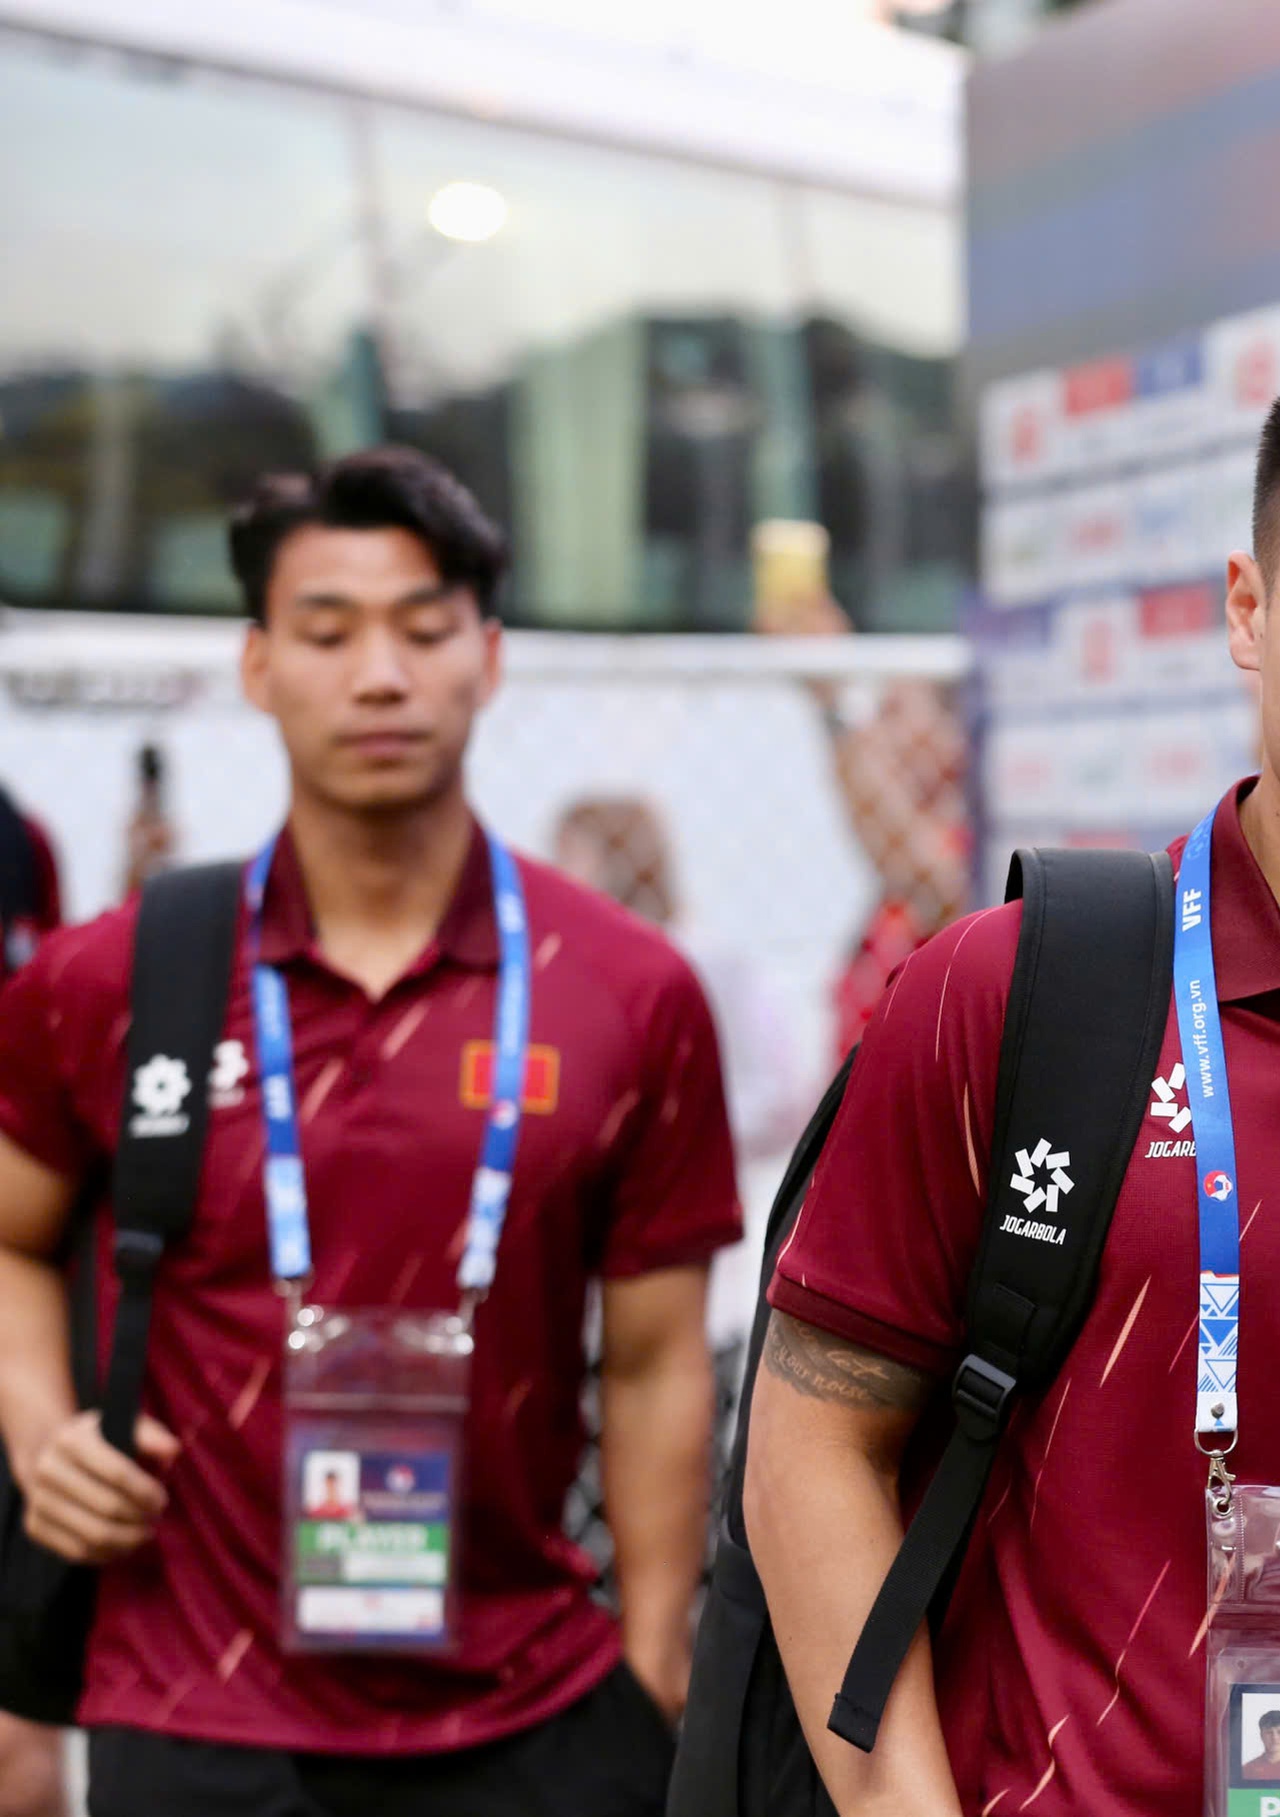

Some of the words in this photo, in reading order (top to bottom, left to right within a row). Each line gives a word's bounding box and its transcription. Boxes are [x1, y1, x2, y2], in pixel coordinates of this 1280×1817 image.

[1182, 888, 1202, 932] VFF
[1192, 979, 1214, 1098] www.vff.org.vn
[1000, 1214, 1067, 1245] JOGARBOLA
